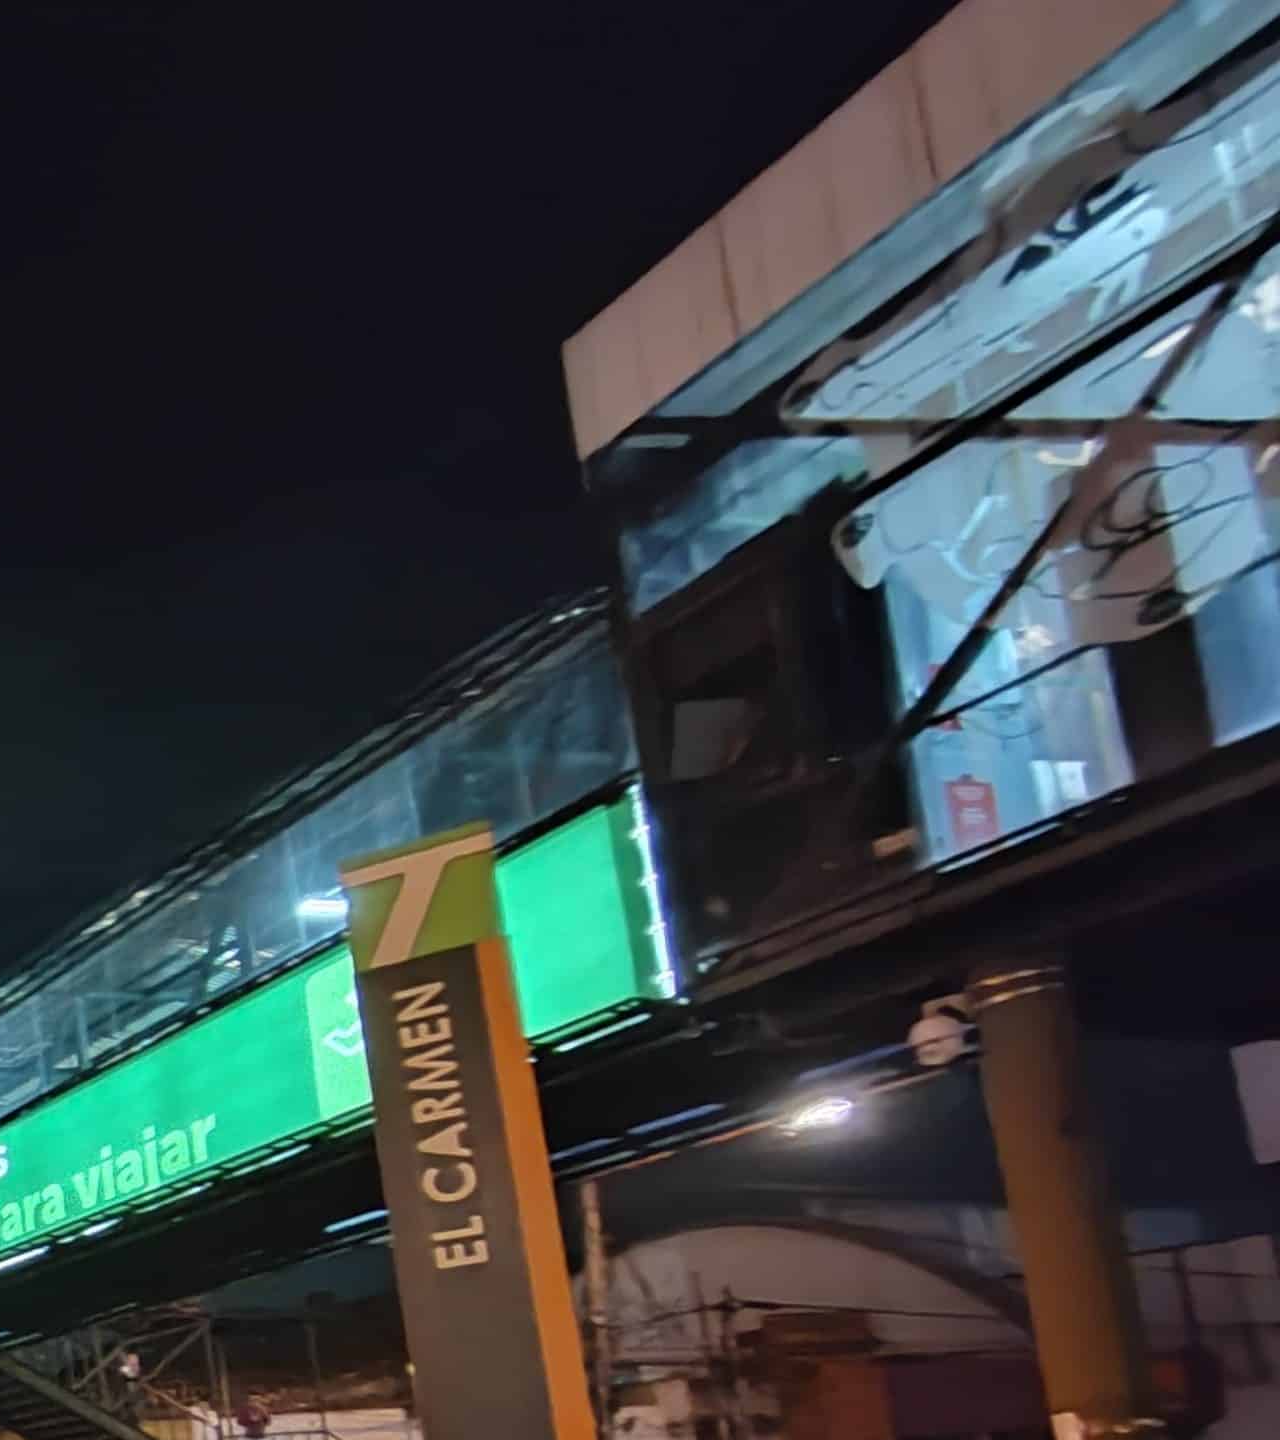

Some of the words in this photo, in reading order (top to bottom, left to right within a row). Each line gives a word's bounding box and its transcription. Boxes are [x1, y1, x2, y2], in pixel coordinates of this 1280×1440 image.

[393, 982, 478, 1202] CARMEN
[71, 1113, 216, 1209] viajar
[432, 1215, 489, 1270] EL
